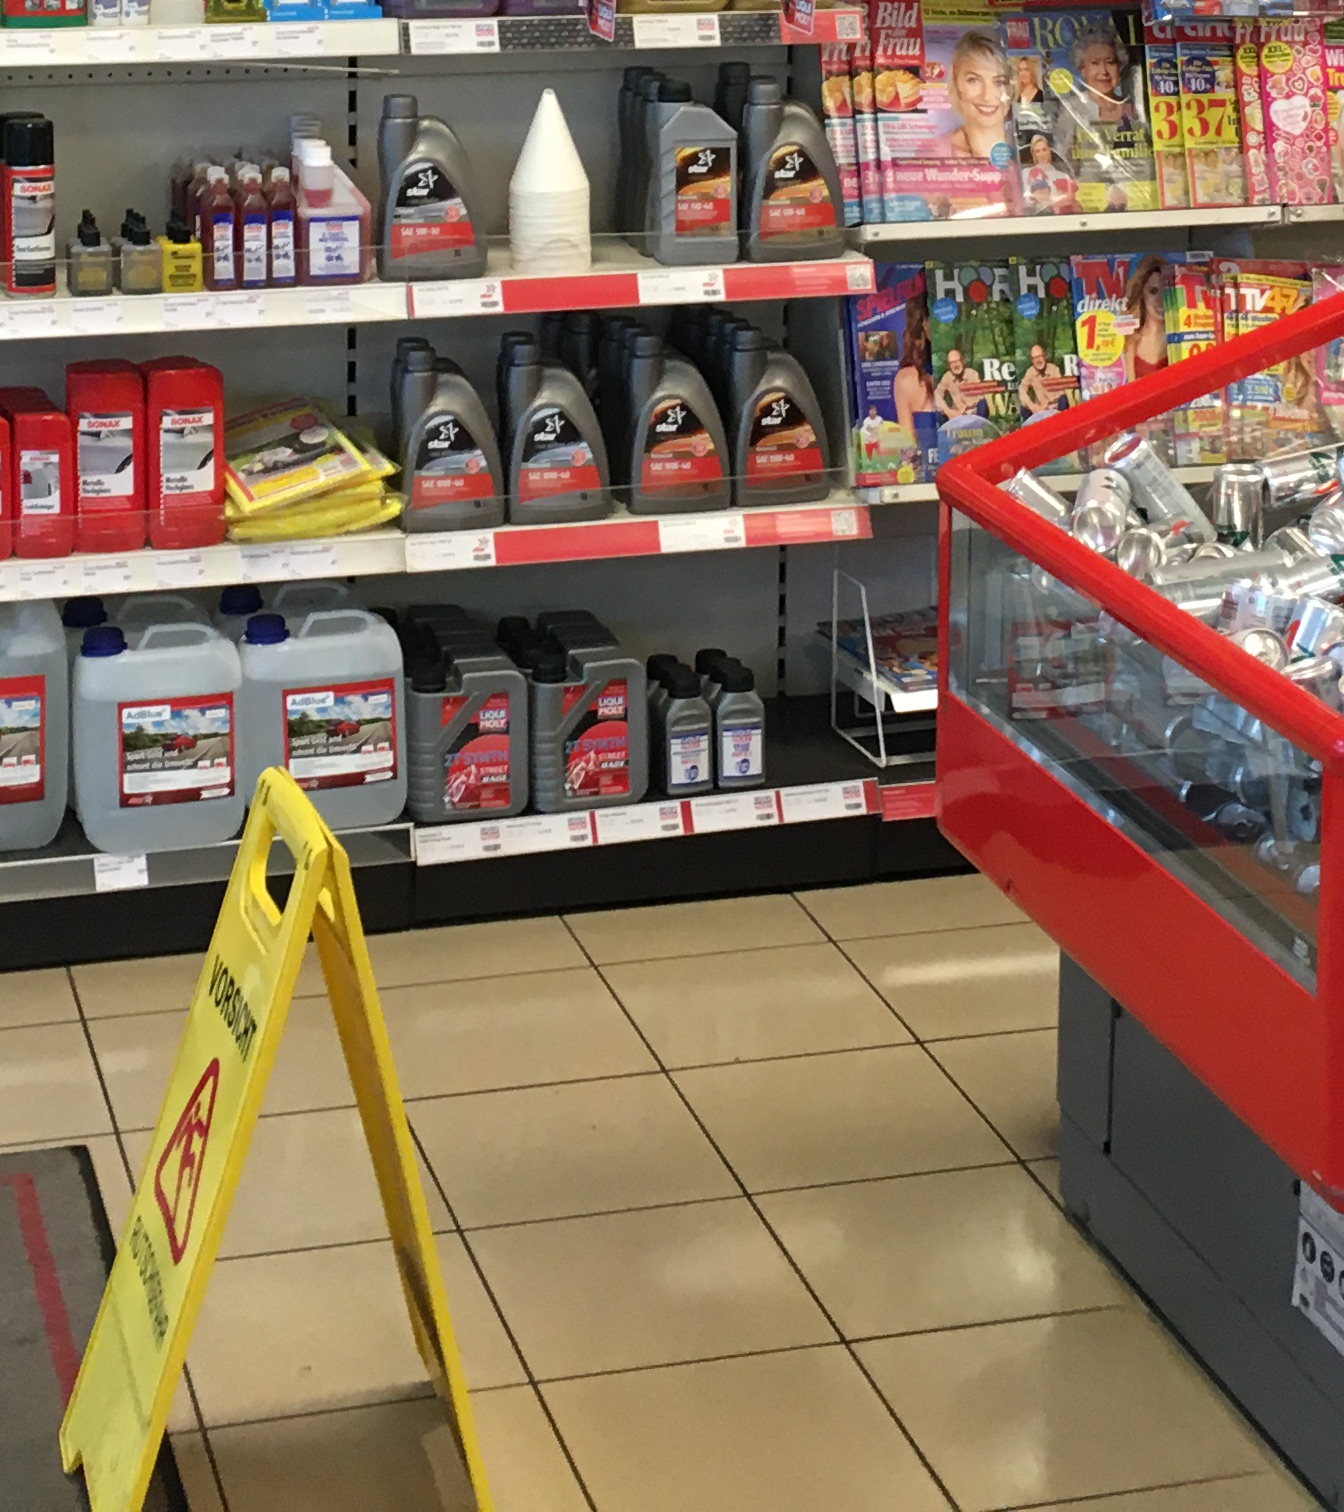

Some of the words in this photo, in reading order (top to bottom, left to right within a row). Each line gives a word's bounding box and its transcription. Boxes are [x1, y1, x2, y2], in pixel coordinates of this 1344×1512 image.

[875, 1, 918, 28] Bild
[877, 29, 921, 58] Frau
[1185, 98, 1227, 137] 37
[687, 165, 708, 176] star
[774, 169, 796, 179] star
[406, 187, 430, 197] star
[1077, 295, 1129, 313] direkt
[86, 418, 121, 430] SONAX
[169, 416, 203, 428] SONAX
[534, 430, 557, 442] star
[597, 696, 626, 708] LIQUI
[479, 709, 506, 721] LIQUI
[597, 706, 627, 718] MOLY
[479, 719, 508, 731] MOLY
[207, 954, 258, 1063] VORSICHT
